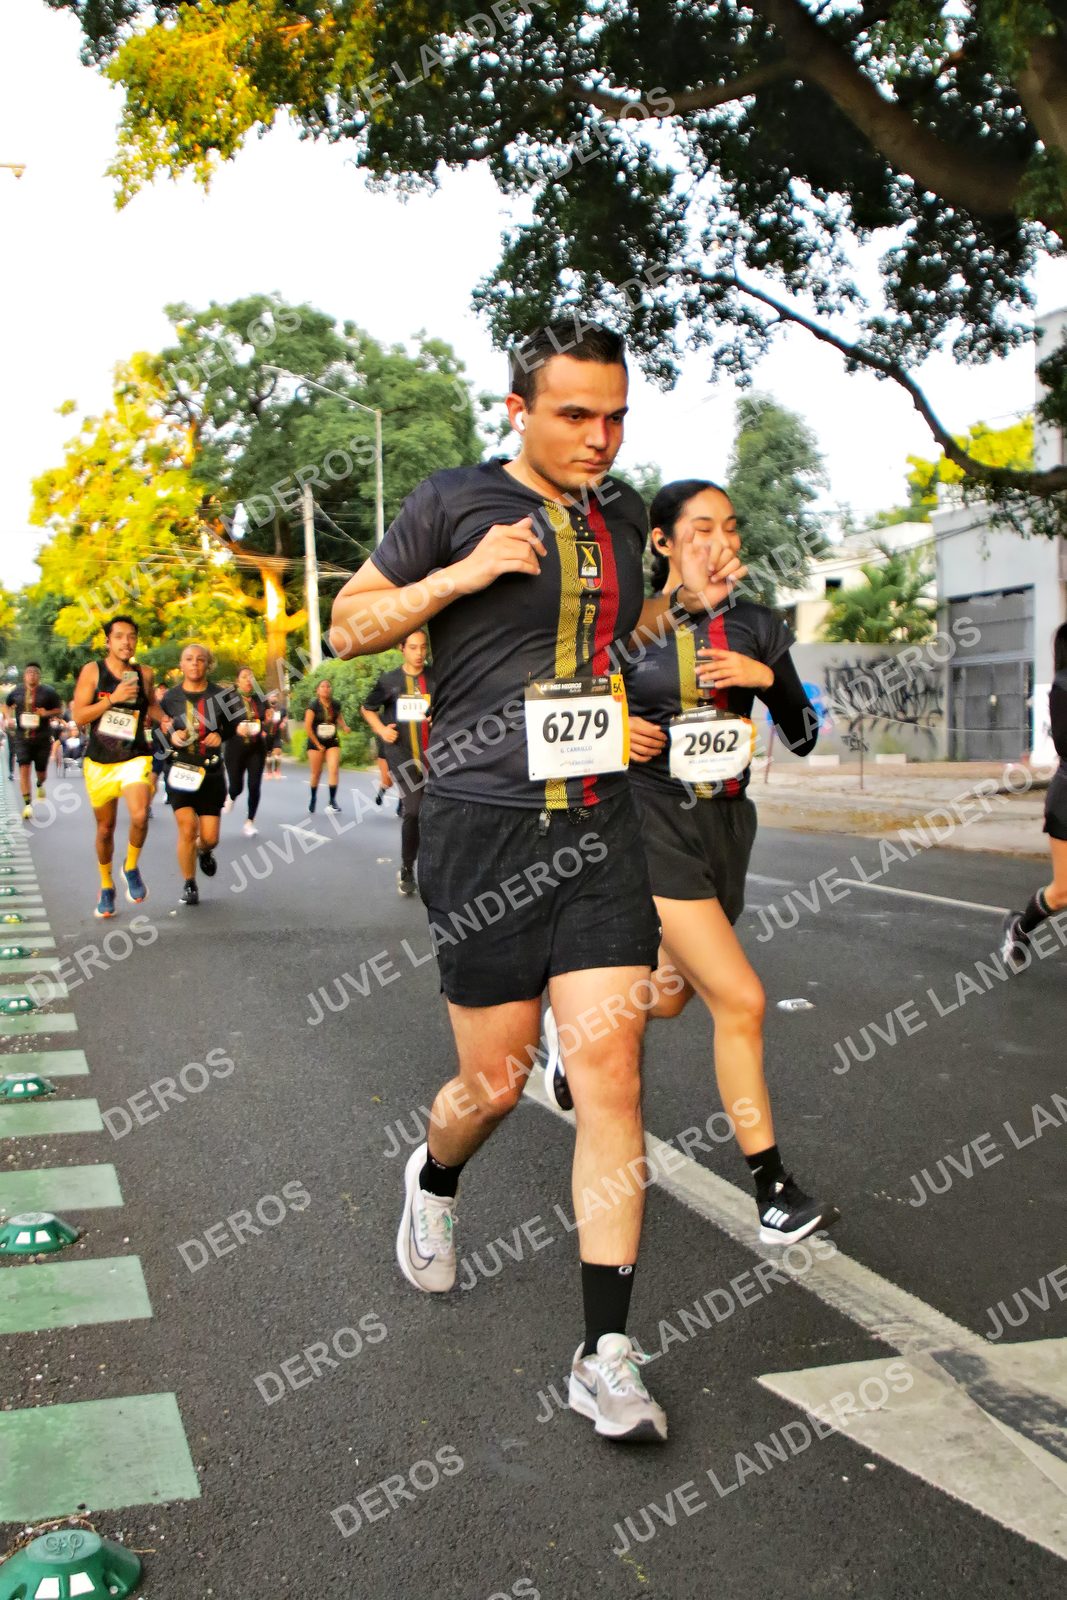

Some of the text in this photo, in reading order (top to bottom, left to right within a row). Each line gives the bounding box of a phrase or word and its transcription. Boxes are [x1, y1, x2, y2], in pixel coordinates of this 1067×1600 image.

[107, 713, 131, 727] 3667
[542, 708, 610, 743] 6279
[683, 729, 739, 756] 2962
